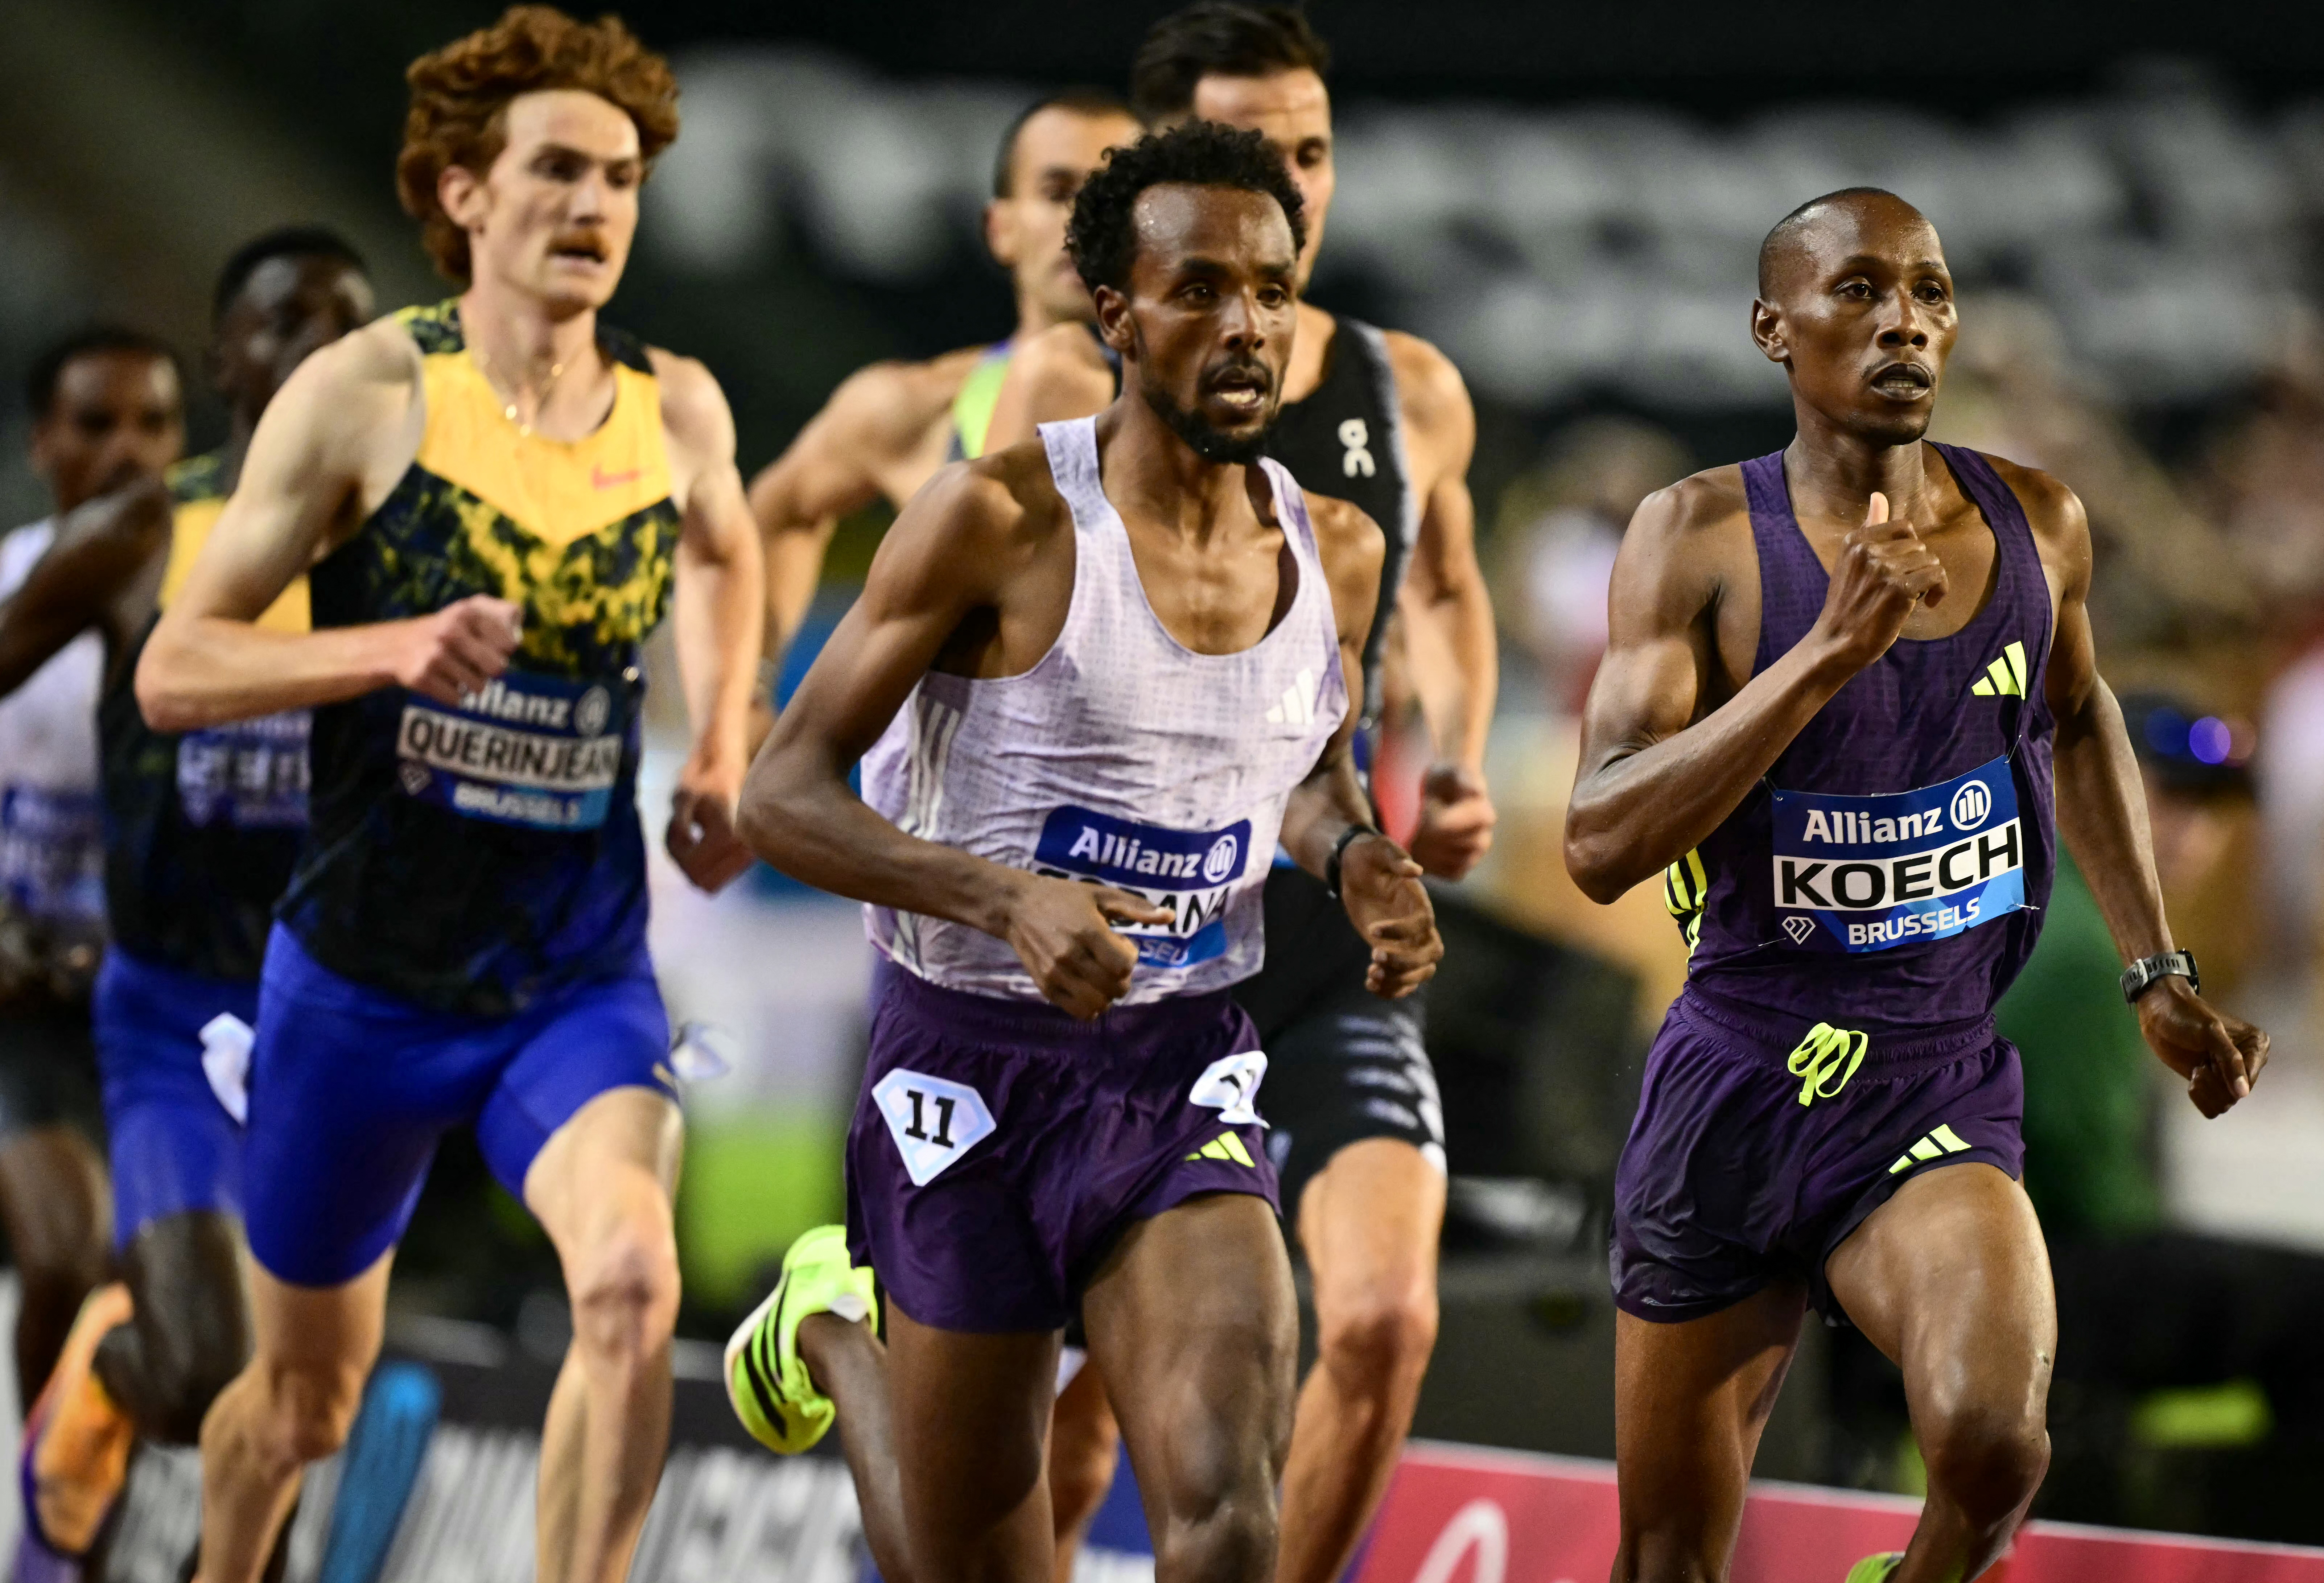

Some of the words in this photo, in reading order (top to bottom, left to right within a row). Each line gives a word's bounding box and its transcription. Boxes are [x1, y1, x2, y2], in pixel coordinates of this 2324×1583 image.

[1068, 825, 1203, 878] Allianz
[1803, 807, 1943, 844] Allianz
[1781, 823, 2019, 907] KOECH
[1848, 896, 1981, 945] BRUSSELS
[905, 1089, 956, 1149] 11
